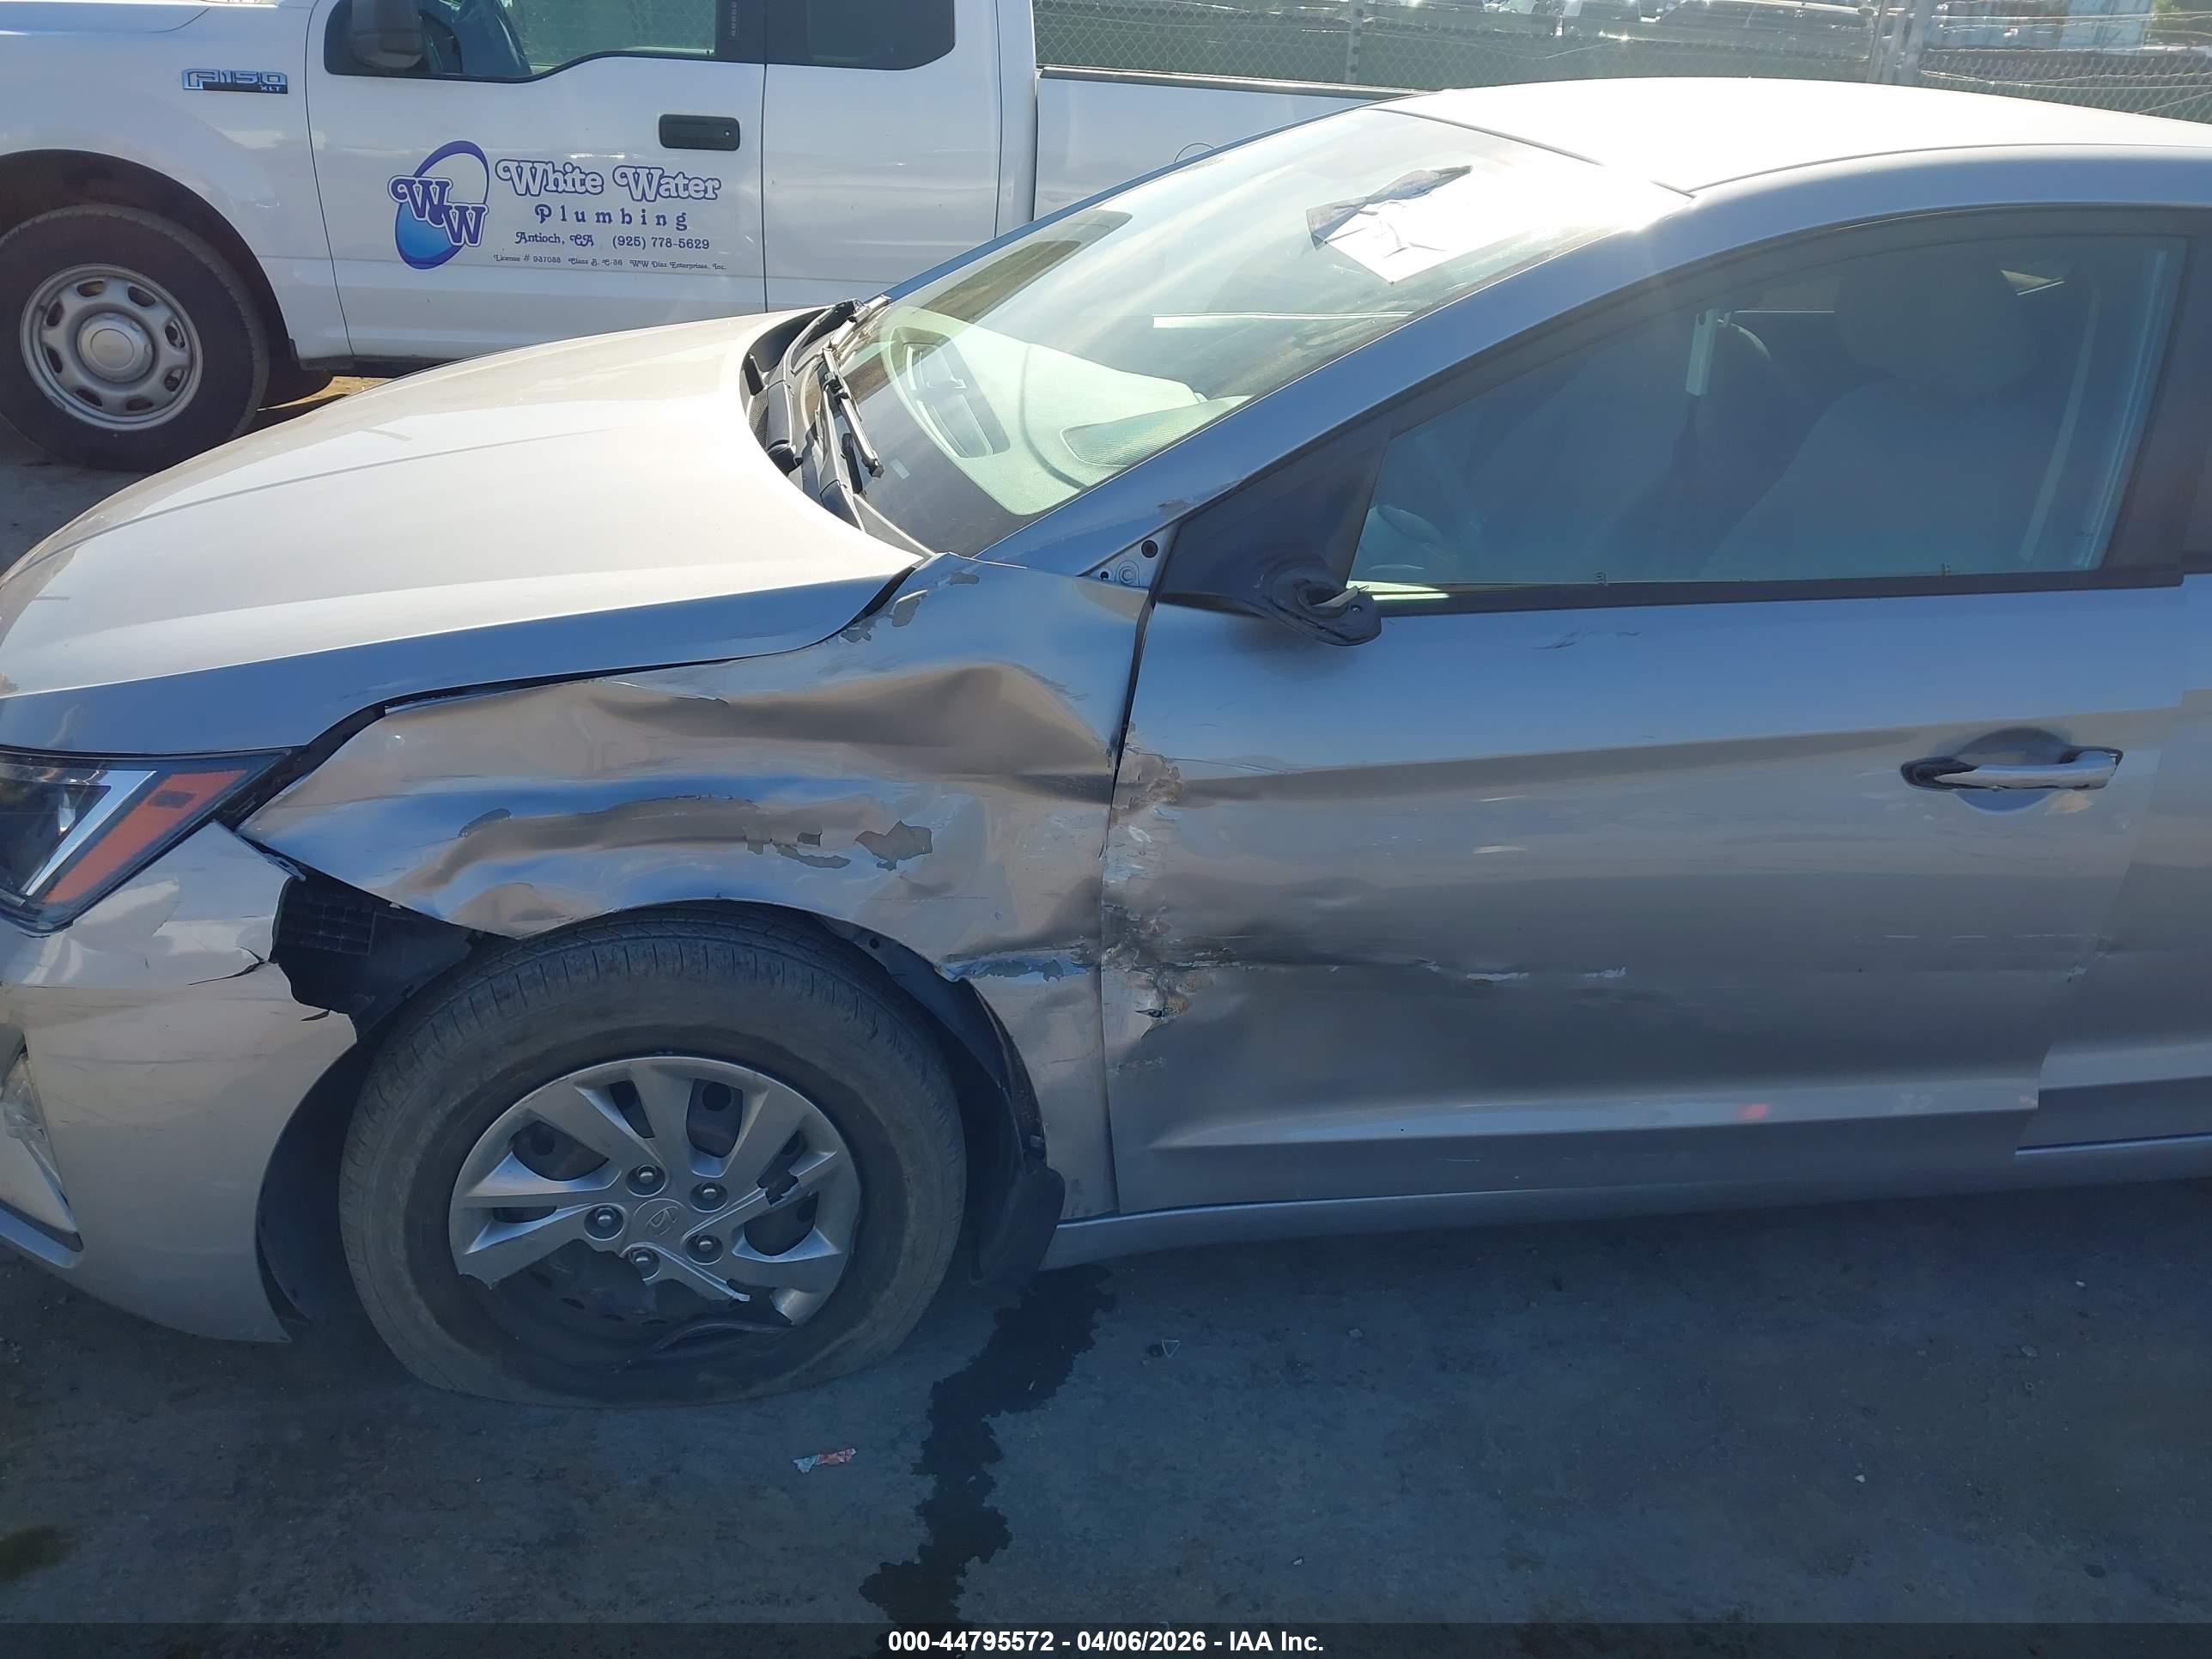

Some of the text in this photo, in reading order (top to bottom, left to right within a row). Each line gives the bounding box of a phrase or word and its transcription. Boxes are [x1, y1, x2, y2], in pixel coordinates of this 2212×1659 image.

[495, 158, 722, 203] White Water
[534, 204, 689, 231] Plumbing
[515, 231, 710, 250] Antioch, CA (925) 778-5629
[523, 253, 530, 262] #
[629, 259, 649, 268] WW
[712, 262, 727, 270] Inc.
